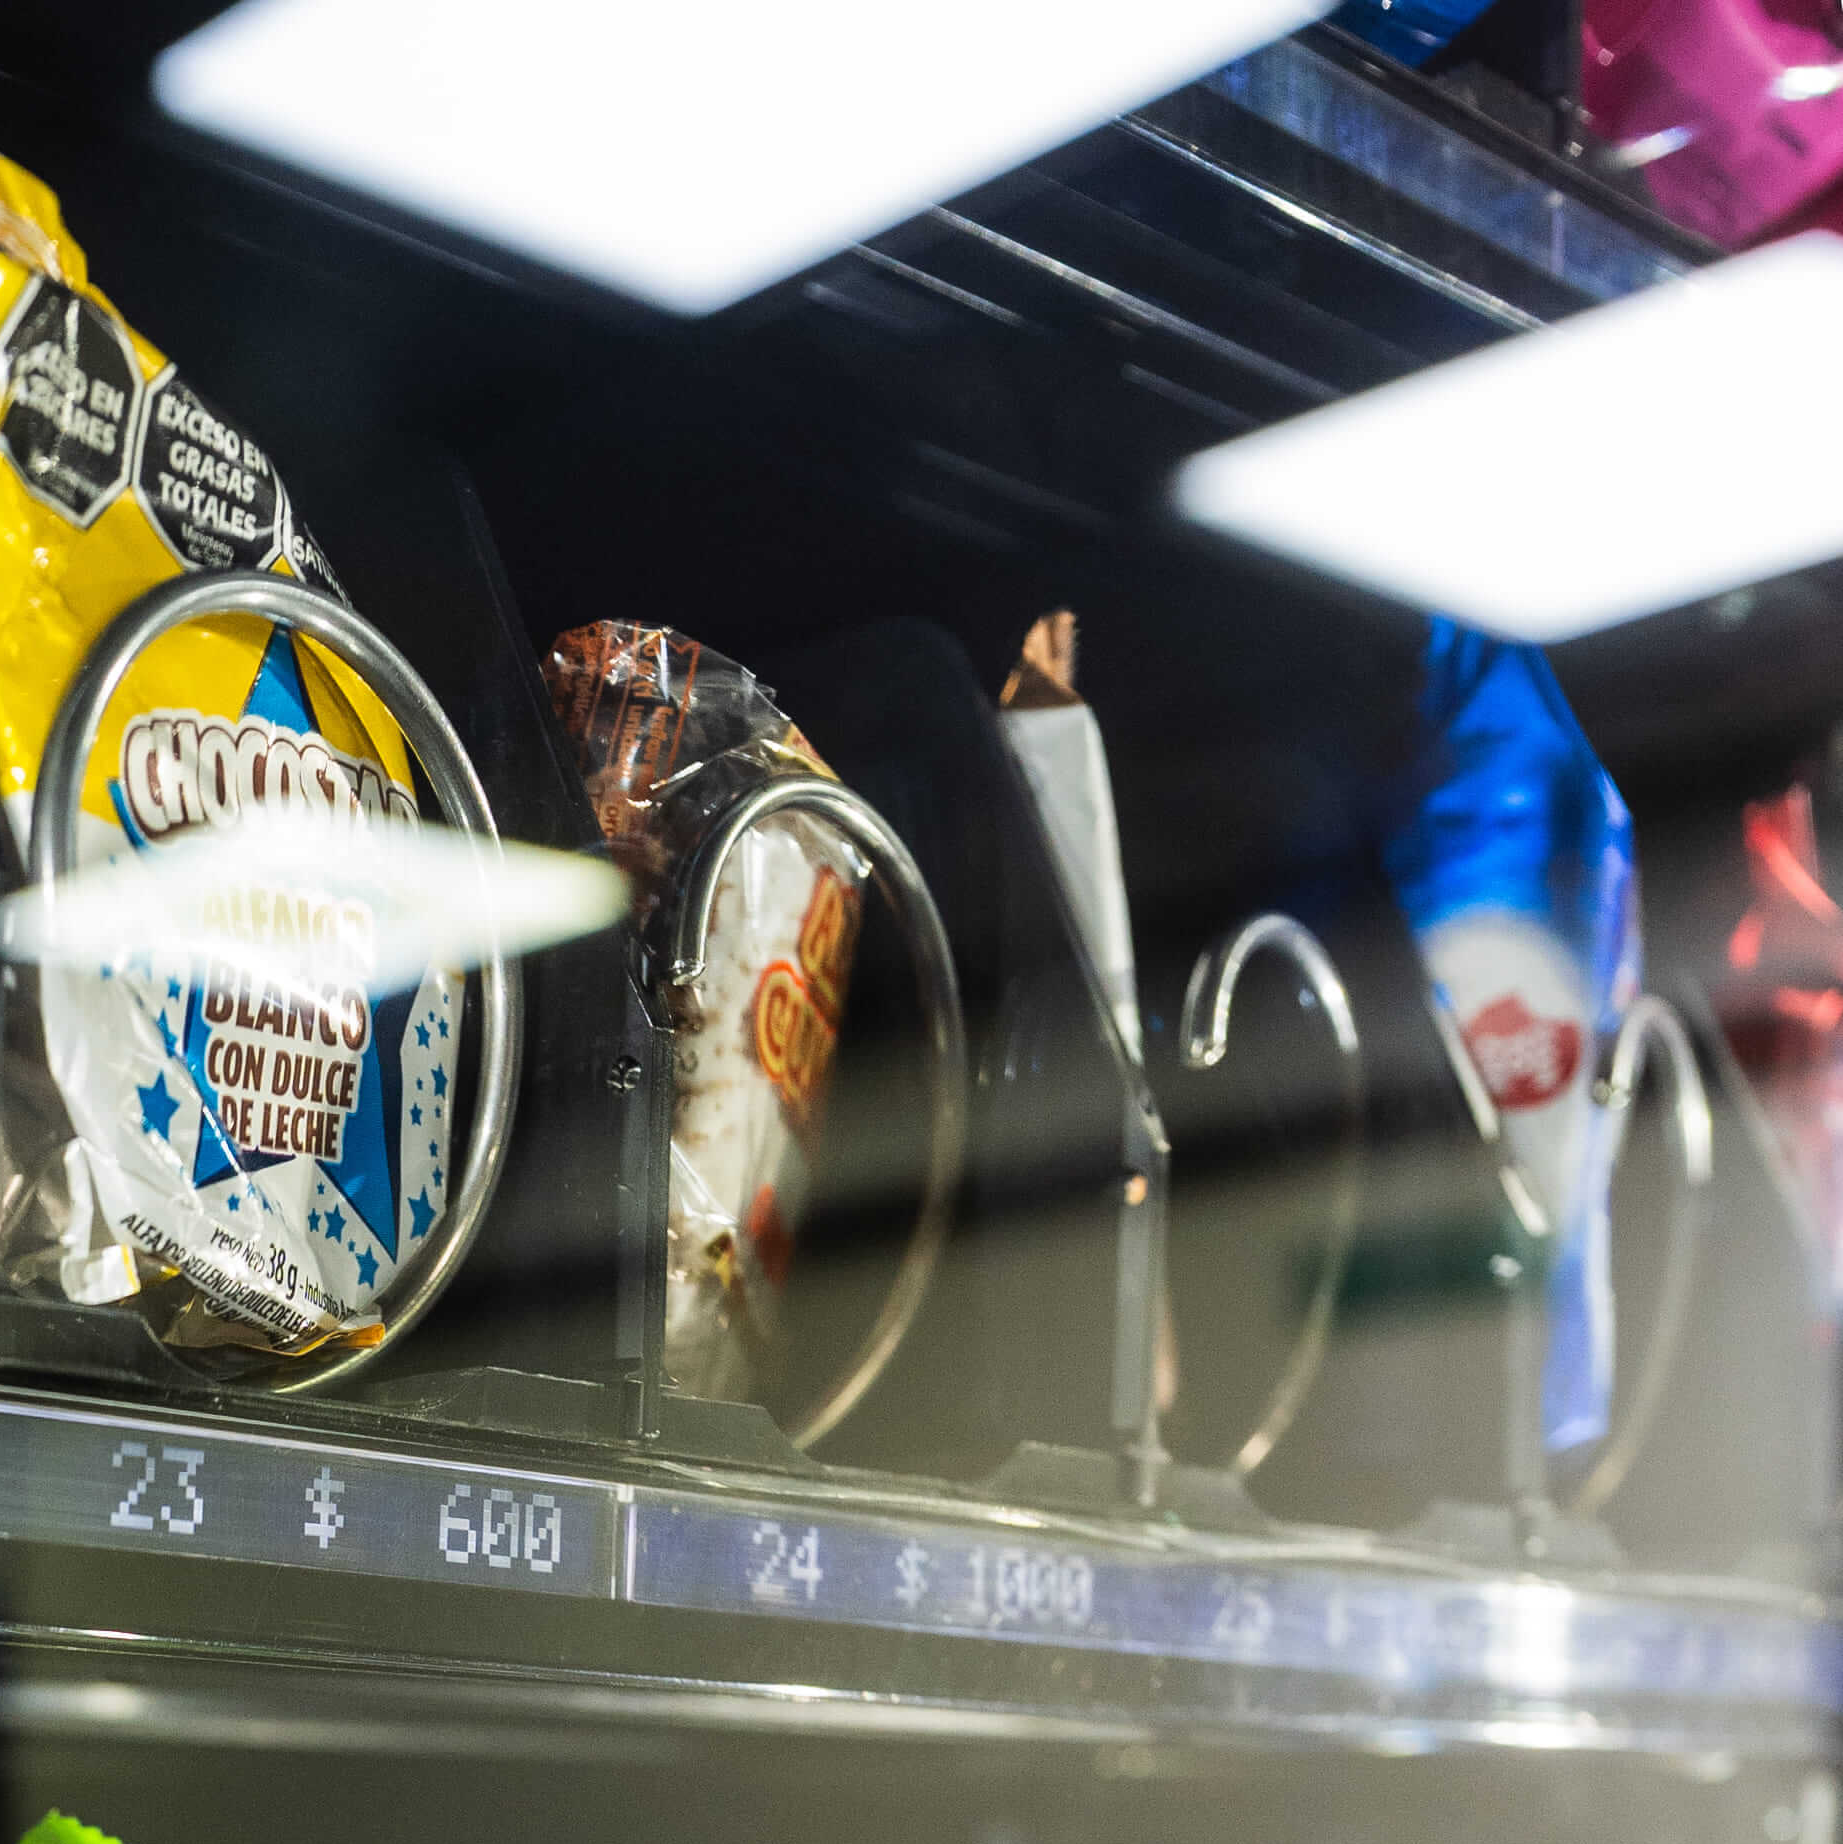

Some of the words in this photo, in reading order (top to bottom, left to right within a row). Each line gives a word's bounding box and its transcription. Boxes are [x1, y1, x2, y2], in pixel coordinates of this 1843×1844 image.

[157, 393, 240, 460] EXCESO
[158, 471, 257, 542] TOTALES
[169, 440, 256, 503] GRASAS
[204, 962, 367, 1052] BLANCO
[206, 1038, 265, 1093] CON
[271, 1050, 357, 1111] DULCE
[220, 1097, 253, 1143] DE
[260, 1106, 341, 1159] LECHE
[266, 1242, 286, 1285] 38
[109, 1440, 206, 1535] 23
[303, 1465, 345, 1549] $
[438, 1484, 562, 1574] 600
[750, 1520, 823, 1601] 24
